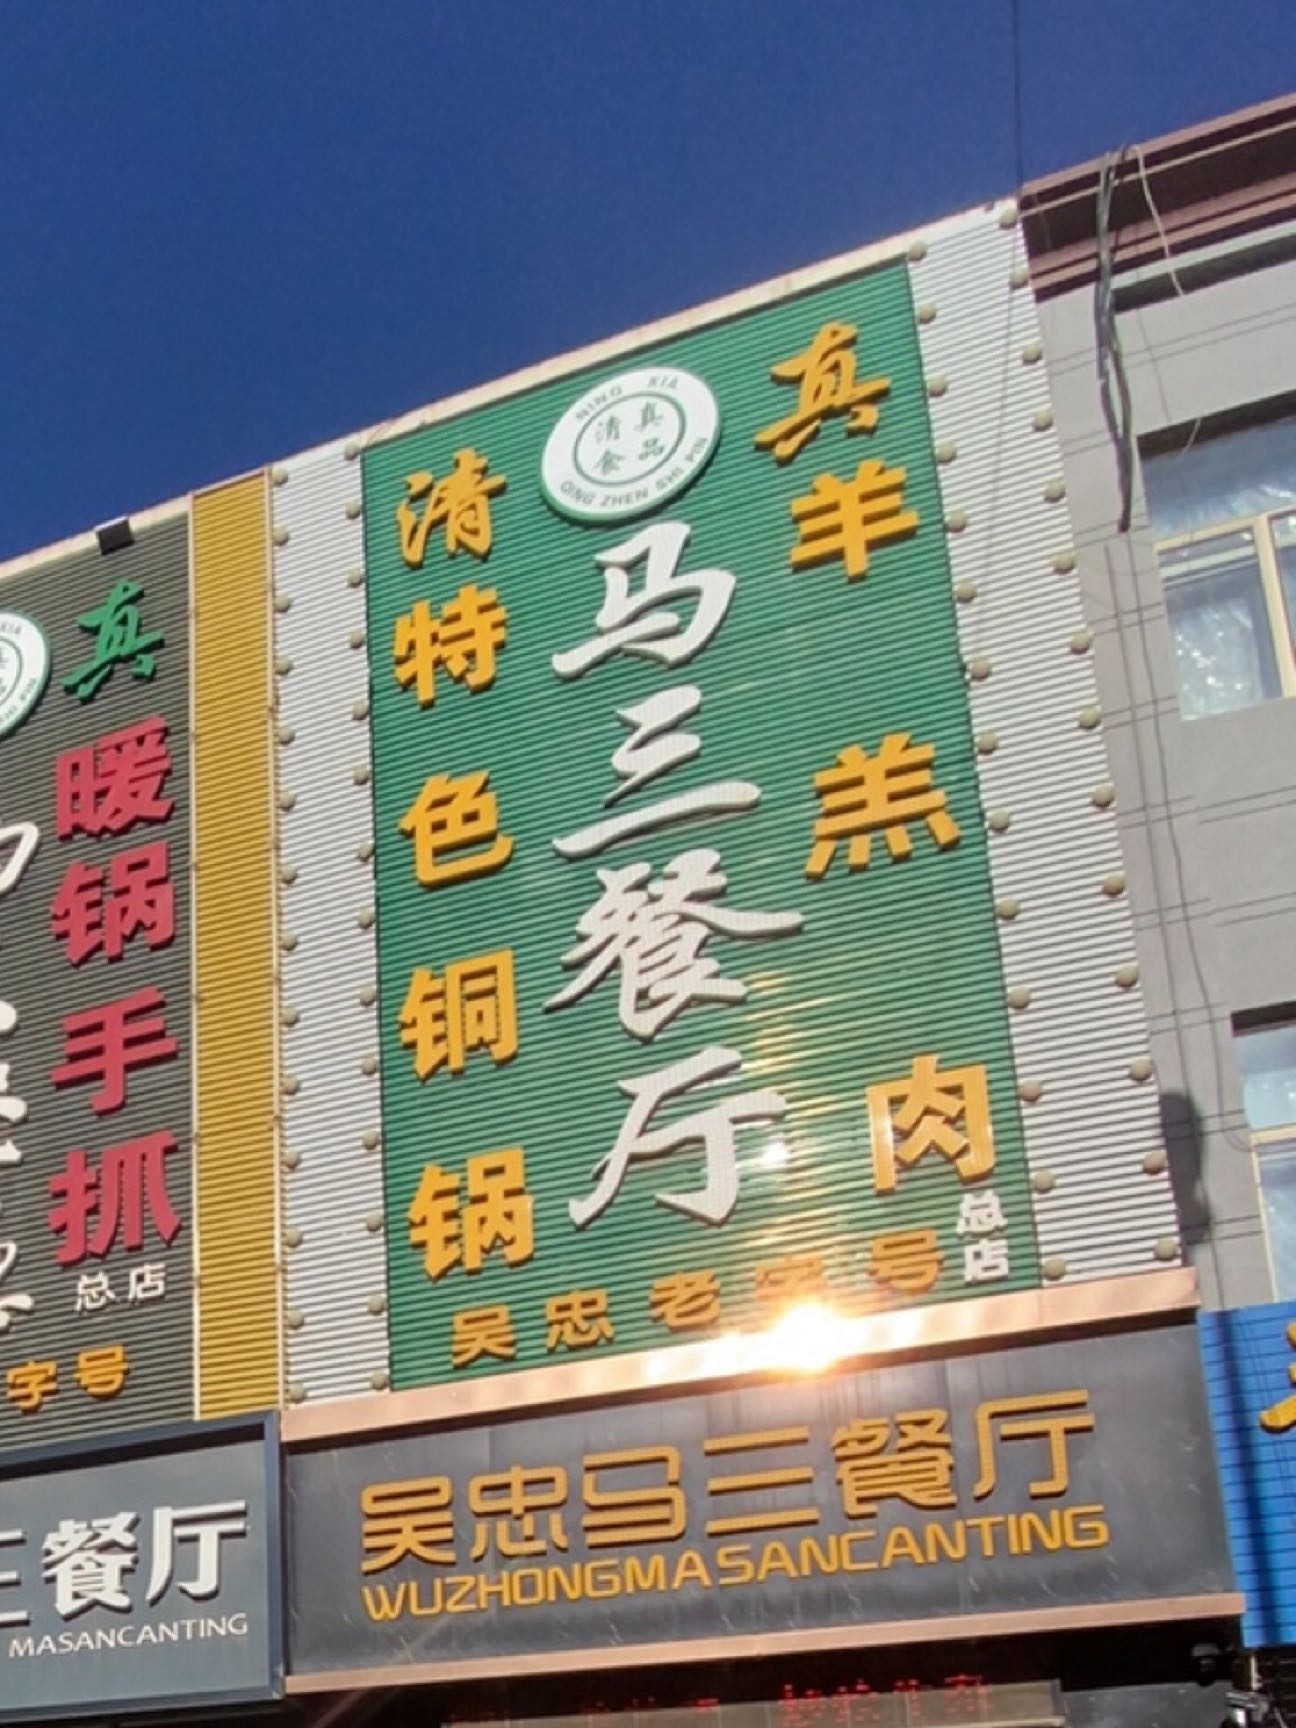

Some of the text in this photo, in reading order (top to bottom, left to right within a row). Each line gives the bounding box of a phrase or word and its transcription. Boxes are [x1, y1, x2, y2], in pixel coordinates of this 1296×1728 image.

[754, 321, 890, 465] 真
[396, 447, 505, 569] 清
[63, 579, 164, 702] 真
[391, 581, 535, 1283] 特色铜锅
[542, 521, 805, 1231] 马三餐厅
[47, 714, 182, 1266] 暖锅手抓
[75, 1262, 167, 1313] 总店
[957, 1188, 1008, 1283] 总店
[359, 1388, 1096, 1576] 吴忠马三餐厅
[362, 1504, 1111, 1623] WUZHONGMASANCANTING
[7, 1612, 249, 1660] MASANCANTING
